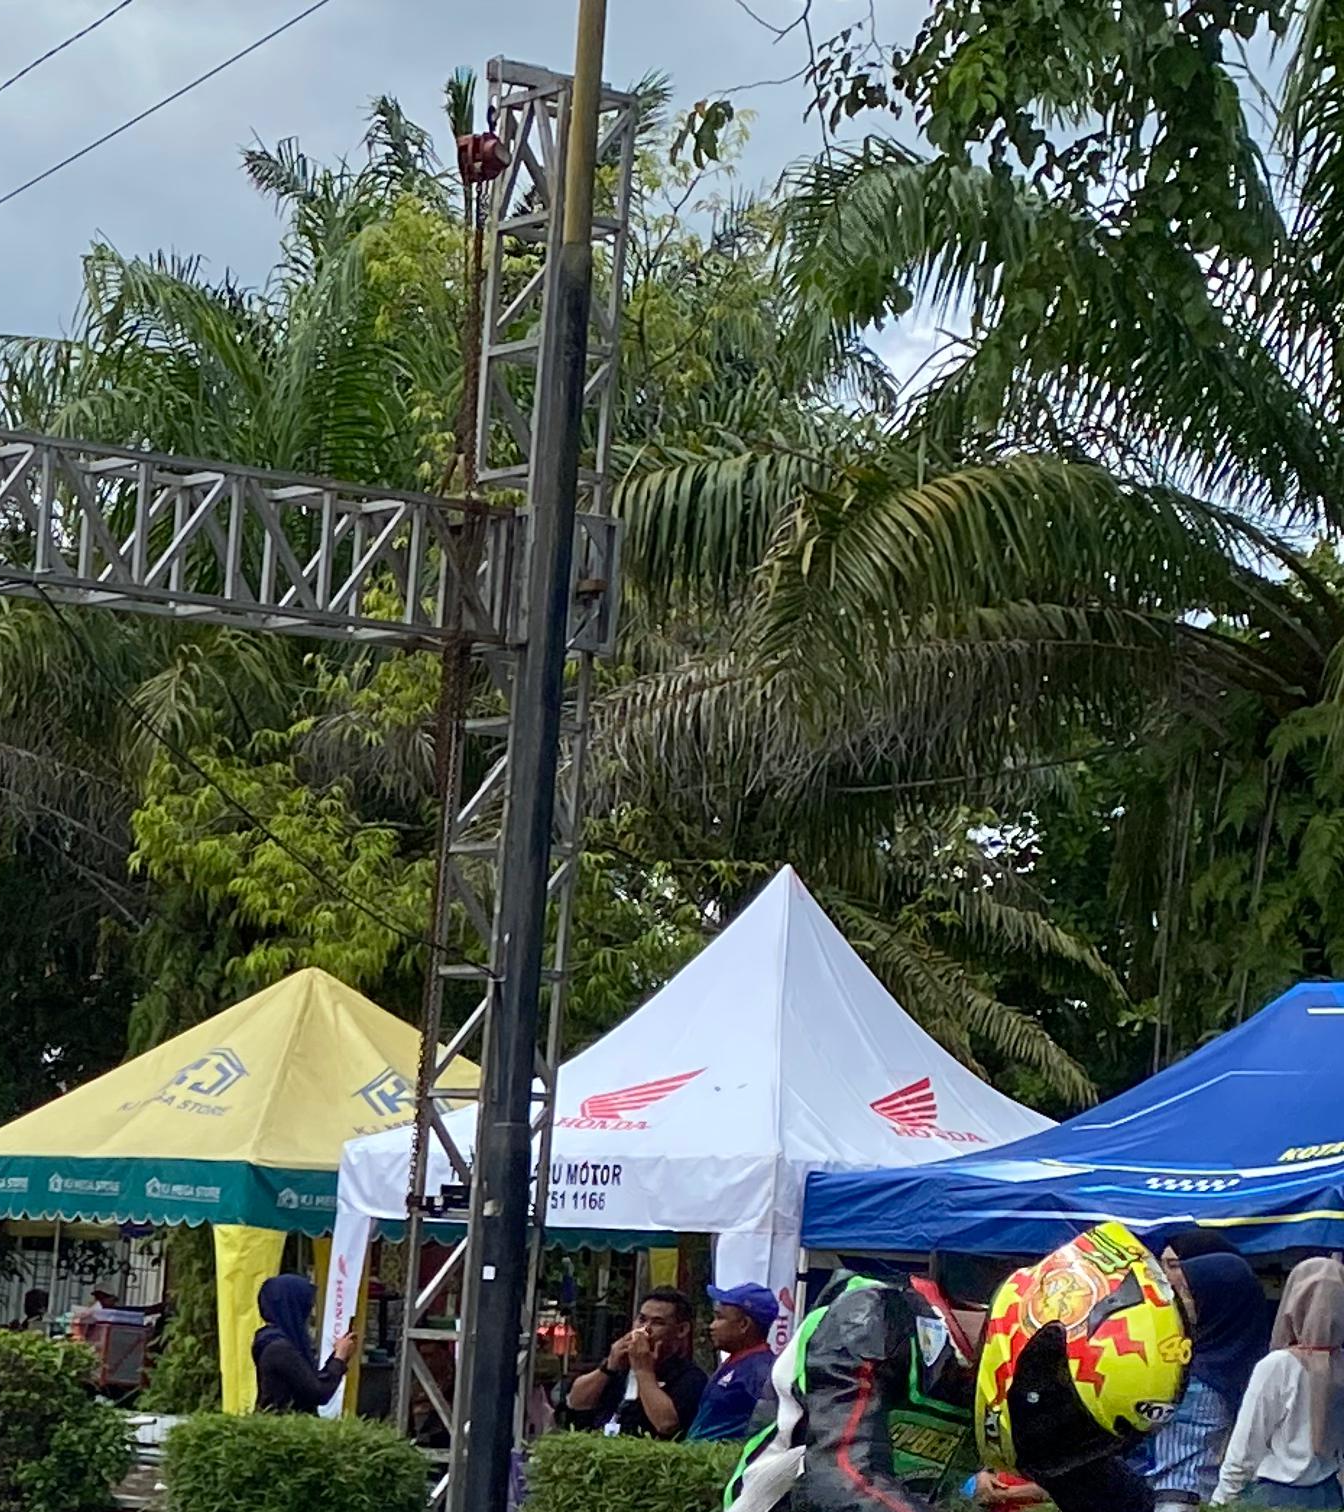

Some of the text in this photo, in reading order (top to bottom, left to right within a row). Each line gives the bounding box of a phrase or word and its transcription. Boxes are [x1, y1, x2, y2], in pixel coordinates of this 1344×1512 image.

[554, 1116, 650, 1131] HONDA
[889, 1124, 988, 1143] HONDA
[566, 1160, 622, 1186] MOTOR
[332, 1279, 343, 1342] HOND
